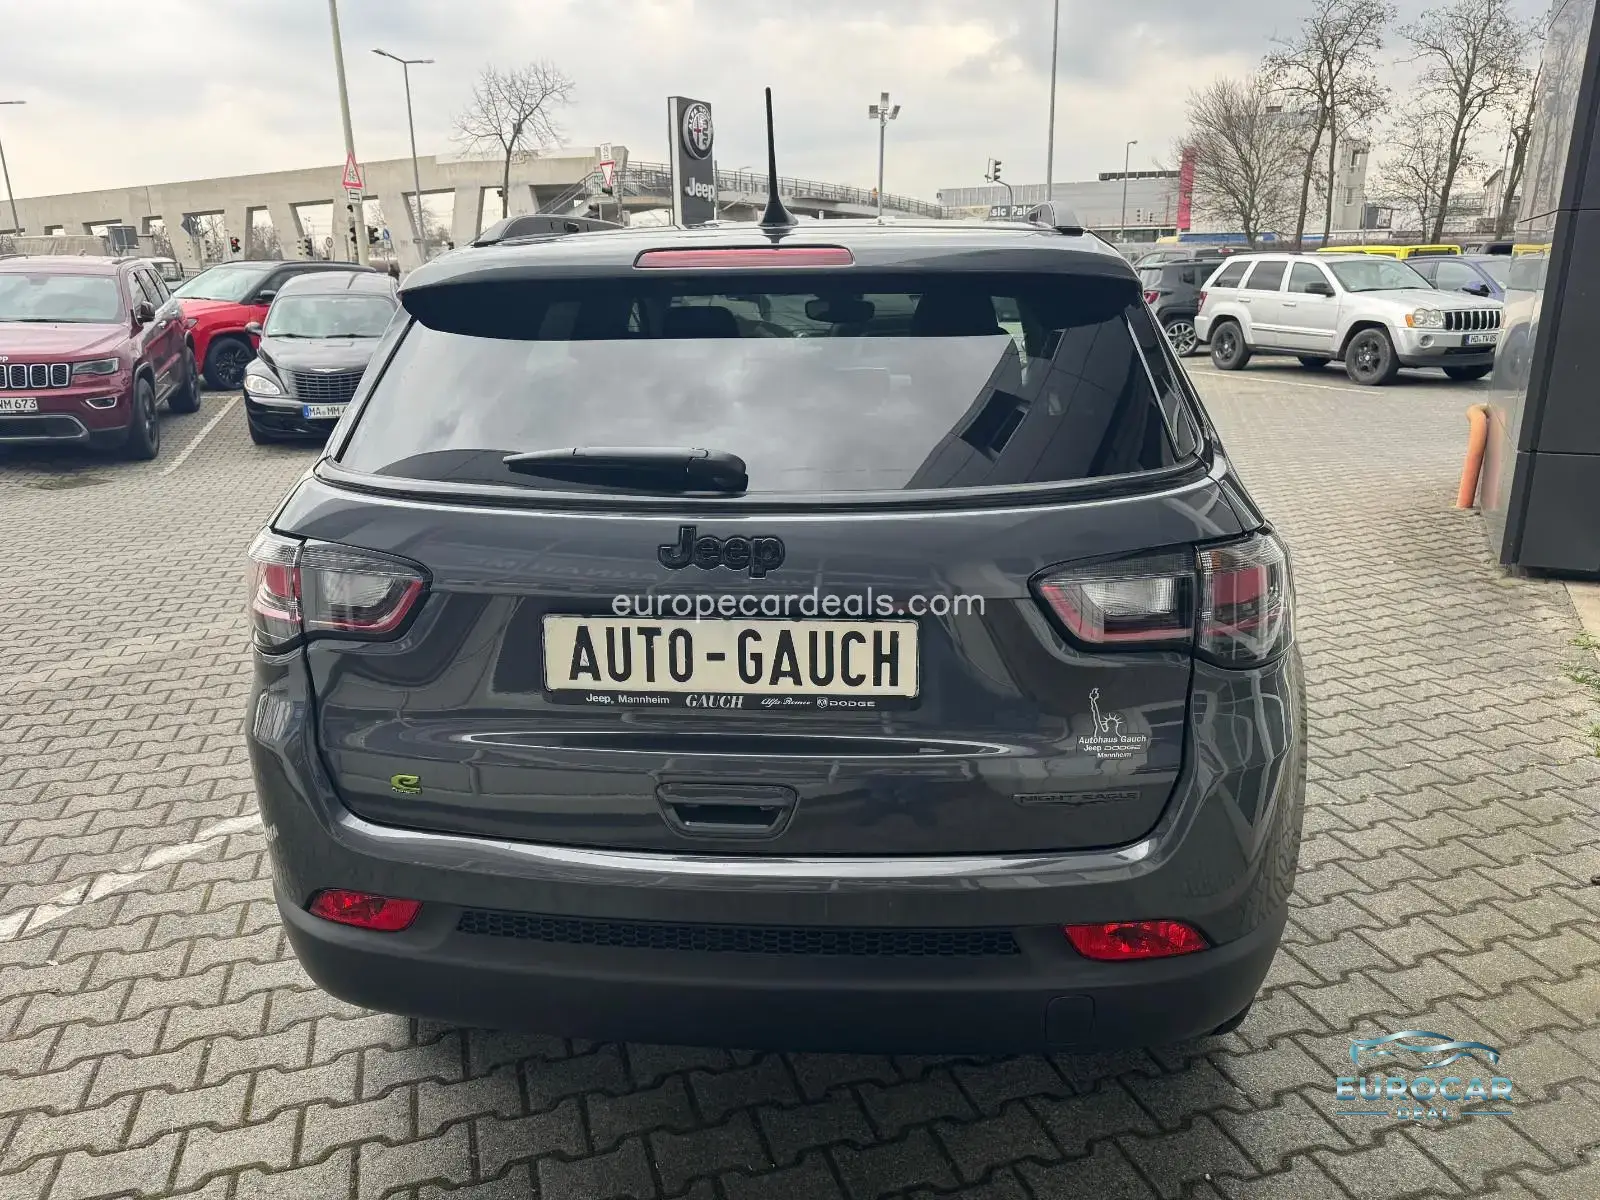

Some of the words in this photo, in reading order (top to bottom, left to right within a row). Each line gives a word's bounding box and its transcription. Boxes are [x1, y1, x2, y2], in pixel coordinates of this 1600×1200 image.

[685, 177, 715, 202] Jeep
[990, 206, 1007, 217] sic
[14, 399, 36, 408] 673
[309, 407, 321, 416] MA
[327, 406, 340, 415] MM
[658, 525, 785, 579] Jeep
[737, 628, 900, 687] GAUCH
[618, 694, 670, 704] Mannheim
[685, 694, 744, 709] GAUCH
[1078, 736, 1118, 744] Autohaus
[1120, 734, 1147, 743] Gauch
